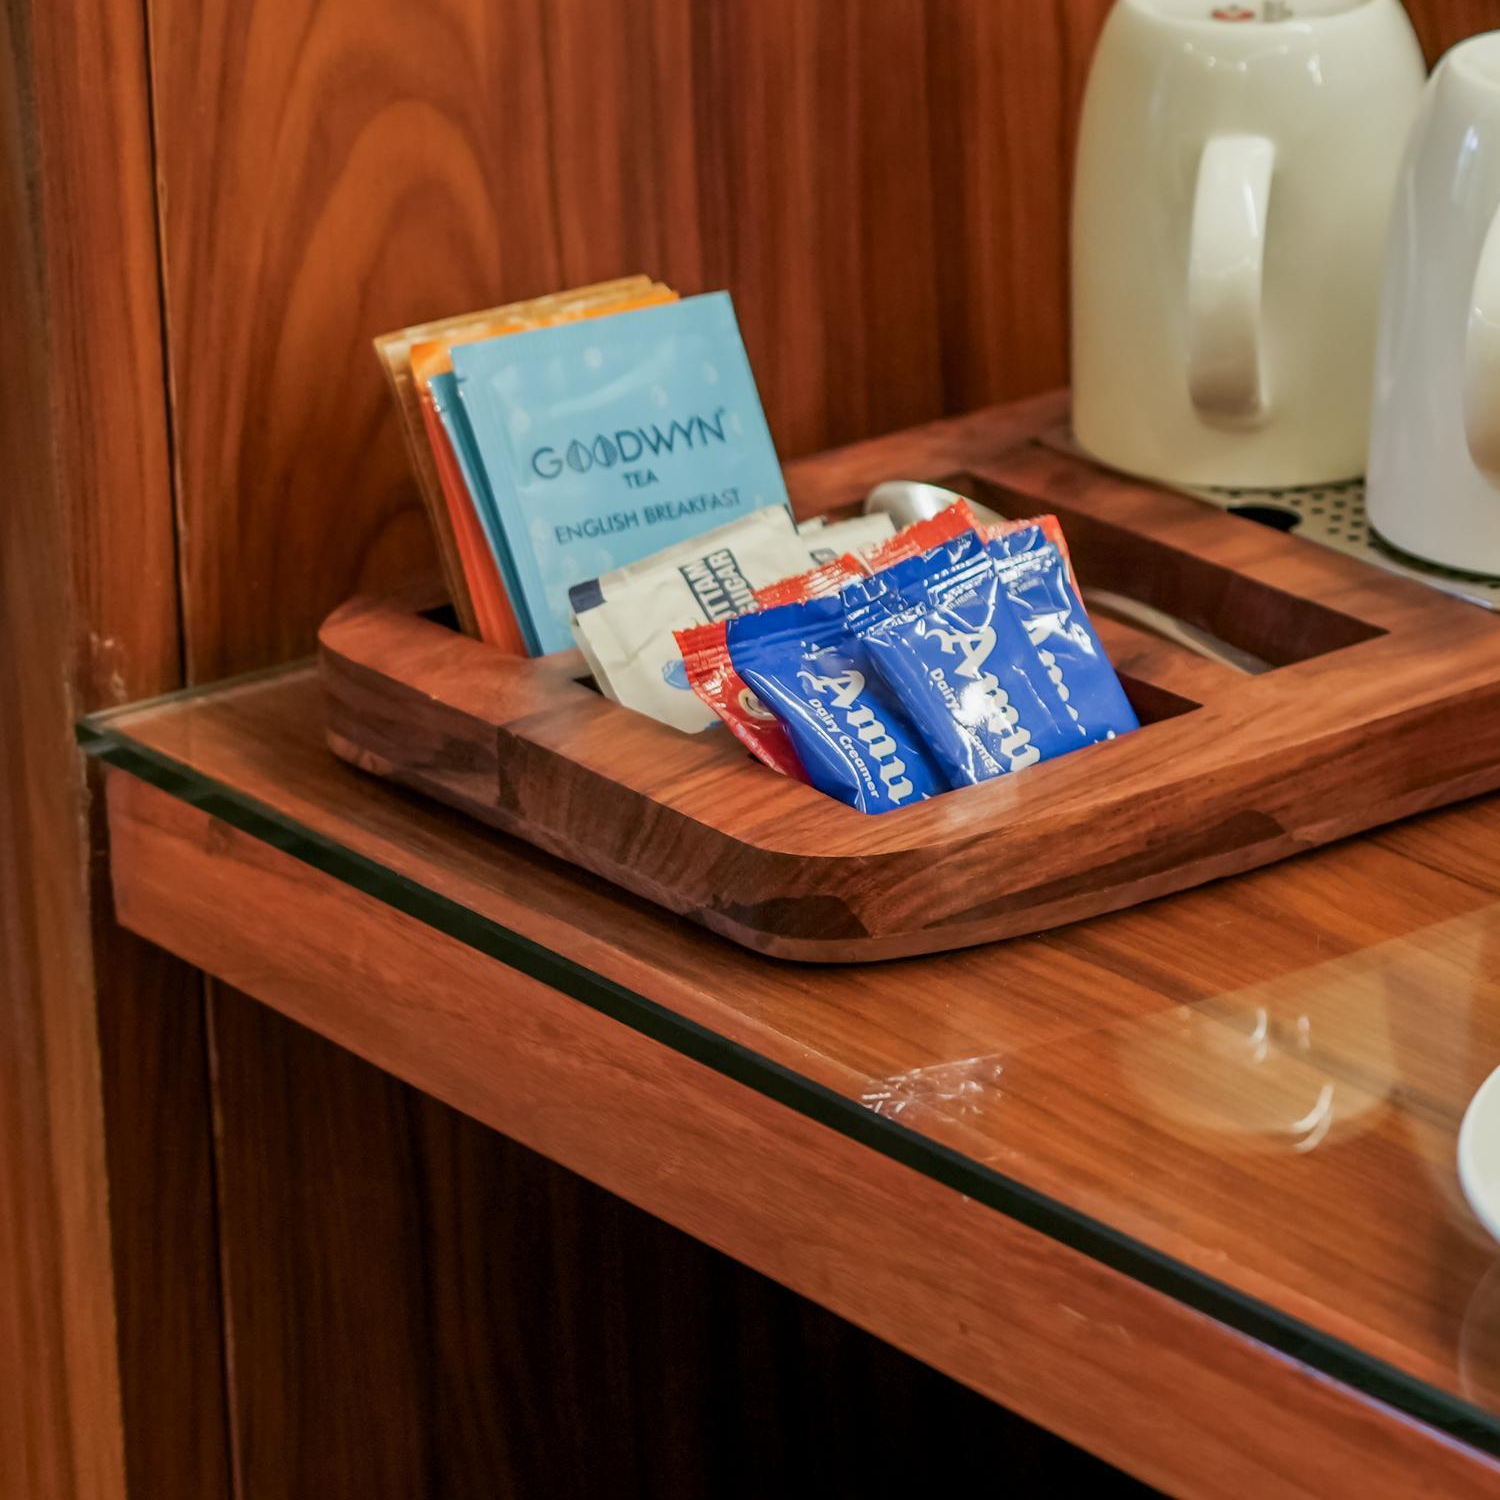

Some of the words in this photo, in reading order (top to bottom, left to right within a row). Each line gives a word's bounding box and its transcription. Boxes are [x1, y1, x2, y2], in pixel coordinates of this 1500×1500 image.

[531, 410, 727, 480] GOODWYN
[621, 468, 660, 490] TEA
[553, 510, 640, 546] ENGLISH
[641, 486, 741, 527] BREAKFAST
[925, 625, 1041, 773] Amu
[930, 667, 962, 711] Dairy
[796, 669, 932, 805] Amu
[808, 697, 842, 736] Dairy
[839, 735, 881, 799] Creamer
